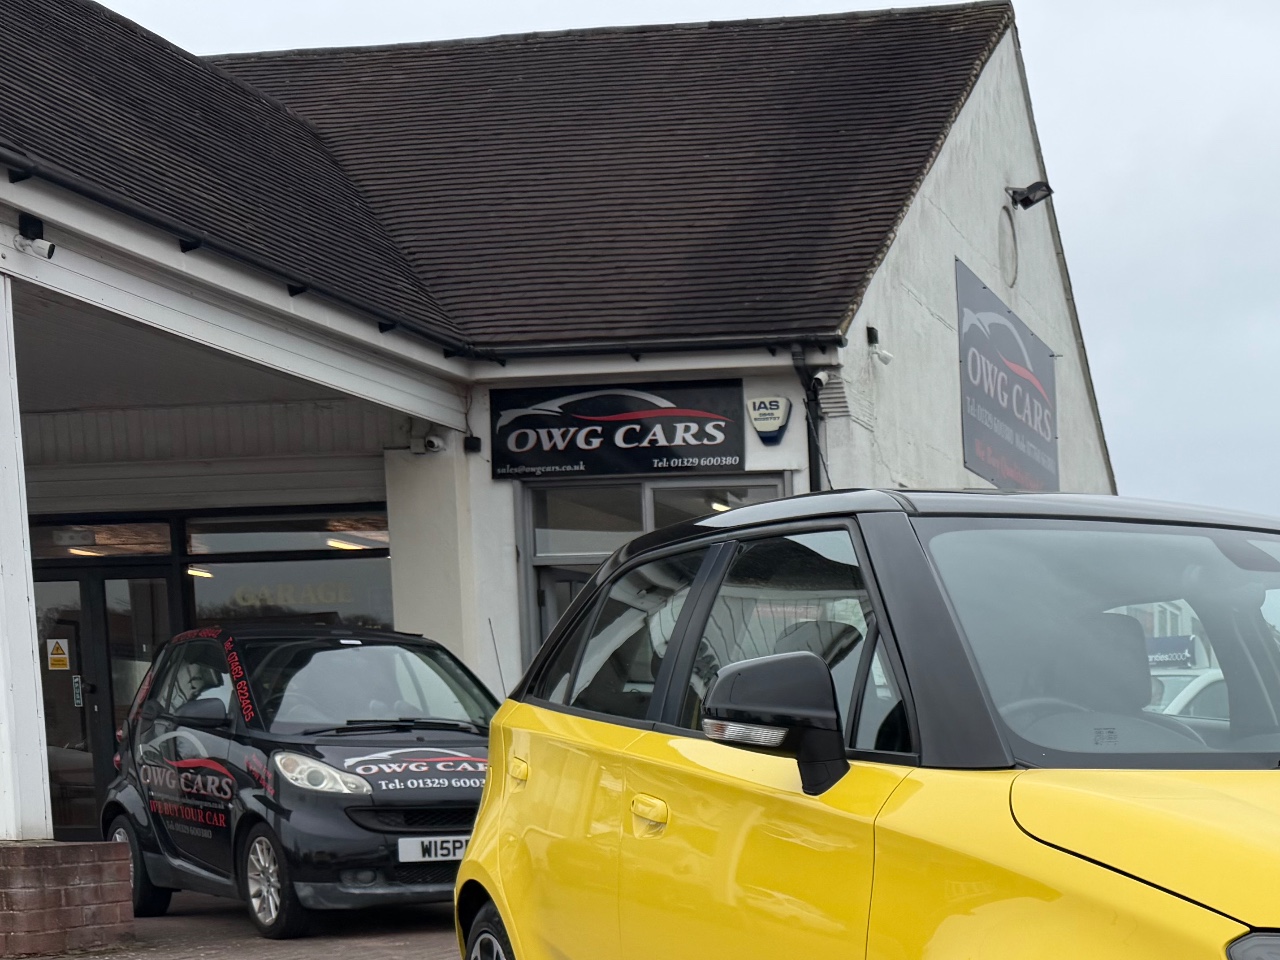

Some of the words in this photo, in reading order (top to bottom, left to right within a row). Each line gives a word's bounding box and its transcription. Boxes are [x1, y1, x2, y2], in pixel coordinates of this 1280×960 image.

[752, 400, 780, 411] IAS
[967, 347, 1009, 409] OWG
[1012, 384, 1051, 443] CARS
[507, 426, 604, 453] OWG
[614, 421, 726, 449] CARS
[653, 457, 669, 468] Tel:
[670, 457, 699, 468] 01329
[700, 456, 740, 466] 600380
[228, 651, 244, 680] 07462
[236, 680, 255, 722] 622405
[356, 762, 429, 775] OWG
[436, 762, 487, 772] CA
[140, 765, 176, 789] OWG
[180, 772, 233, 800] CARS
[379, 779, 404, 790] Tel:
[407, 778, 448, 789] 01329
[452, 778, 485, 788] 6003
[150, 800, 163, 814] WE
[163, 802, 179, 817] BUY
[180, 806, 204, 823] YOUR
[206, 811, 226, 827] CAR
[421, 839, 468, 858] W15P
